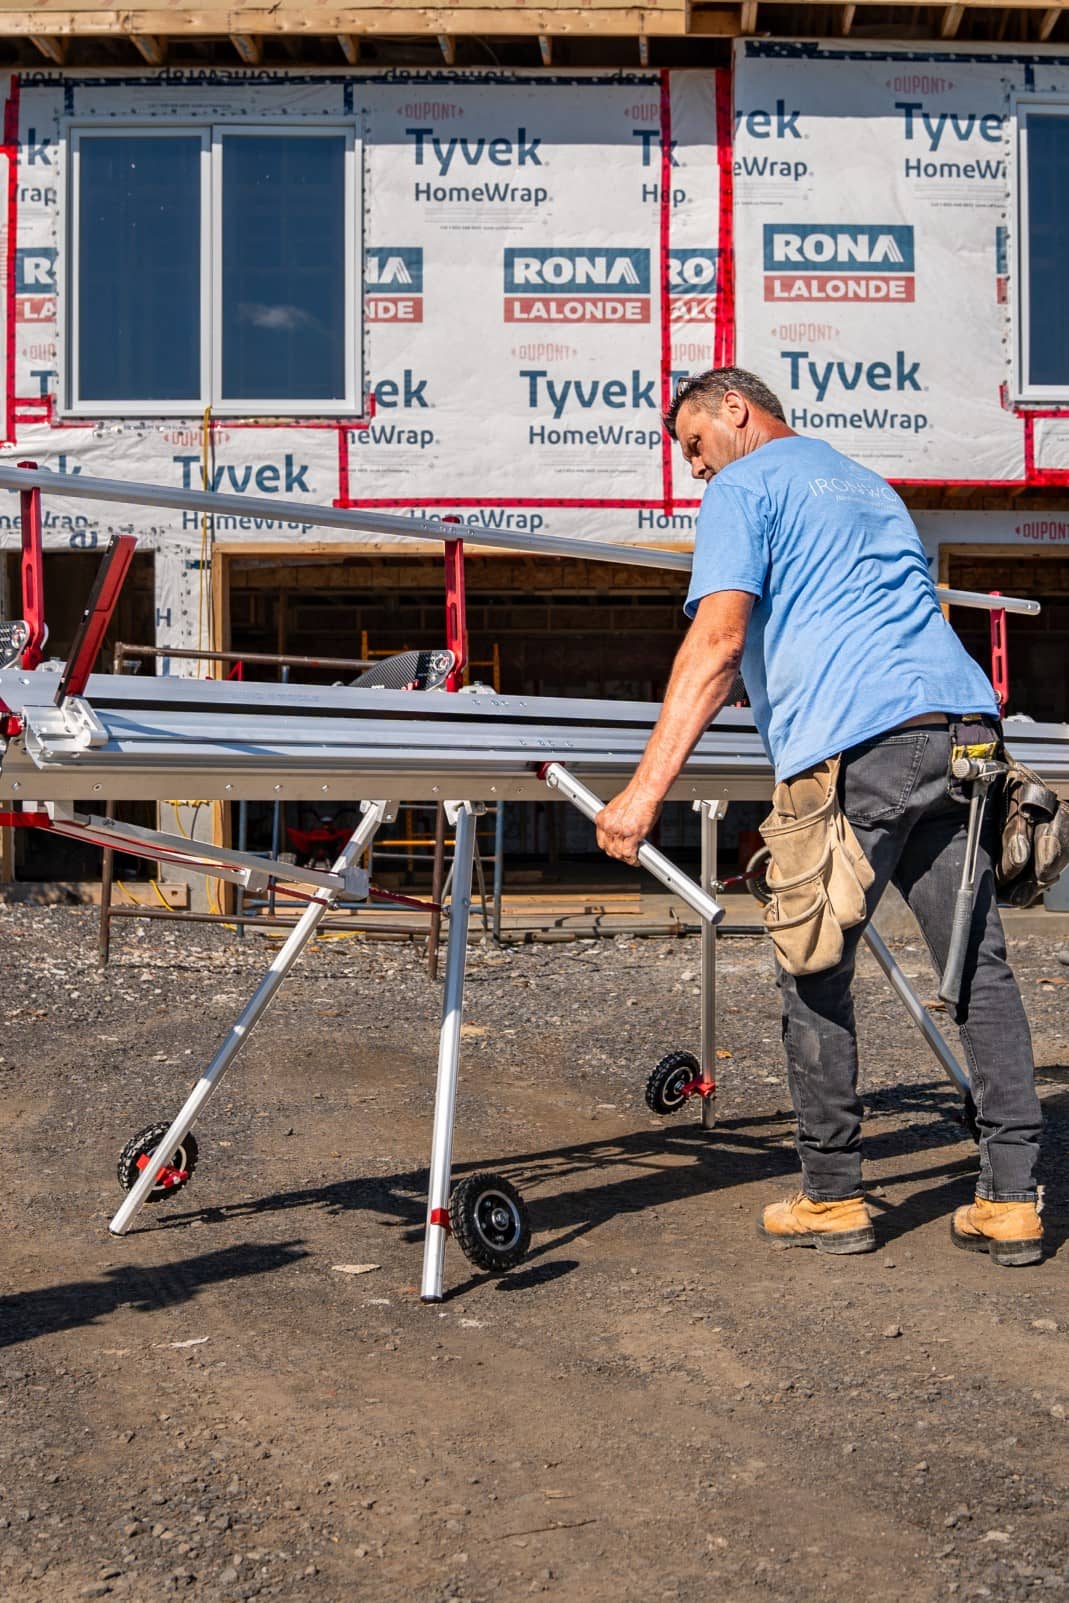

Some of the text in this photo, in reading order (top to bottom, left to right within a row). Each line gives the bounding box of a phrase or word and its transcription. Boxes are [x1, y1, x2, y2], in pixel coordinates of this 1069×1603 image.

[894, 75, 946, 95] DUPONT
[405, 102, 457, 121] DUPONT
[895, 102, 1003, 152] Tyve
[406, 127, 543, 177] Tyvek
[415, 182, 548, 207] HomeWrap
[773, 233, 904, 263] RONA
[513, 256, 641, 285] RONA
[774, 279, 906, 299] LALONDE
[513, 301, 642, 320] LALONDE
[779, 322, 833, 343] DUPONT
[519, 343, 571, 362] DUPONT
[365, 369, 428, 408] ek
[781, 350, 922, 402] Tyvek
[519, 370, 657, 419] Tyvek
[791, 408, 928, 434] HomeWrap
[529, 424, 662, 450] HomeWrap
[638, 509, 697, 529] Hom
[1023, 521, 1069, 541] DUPON
